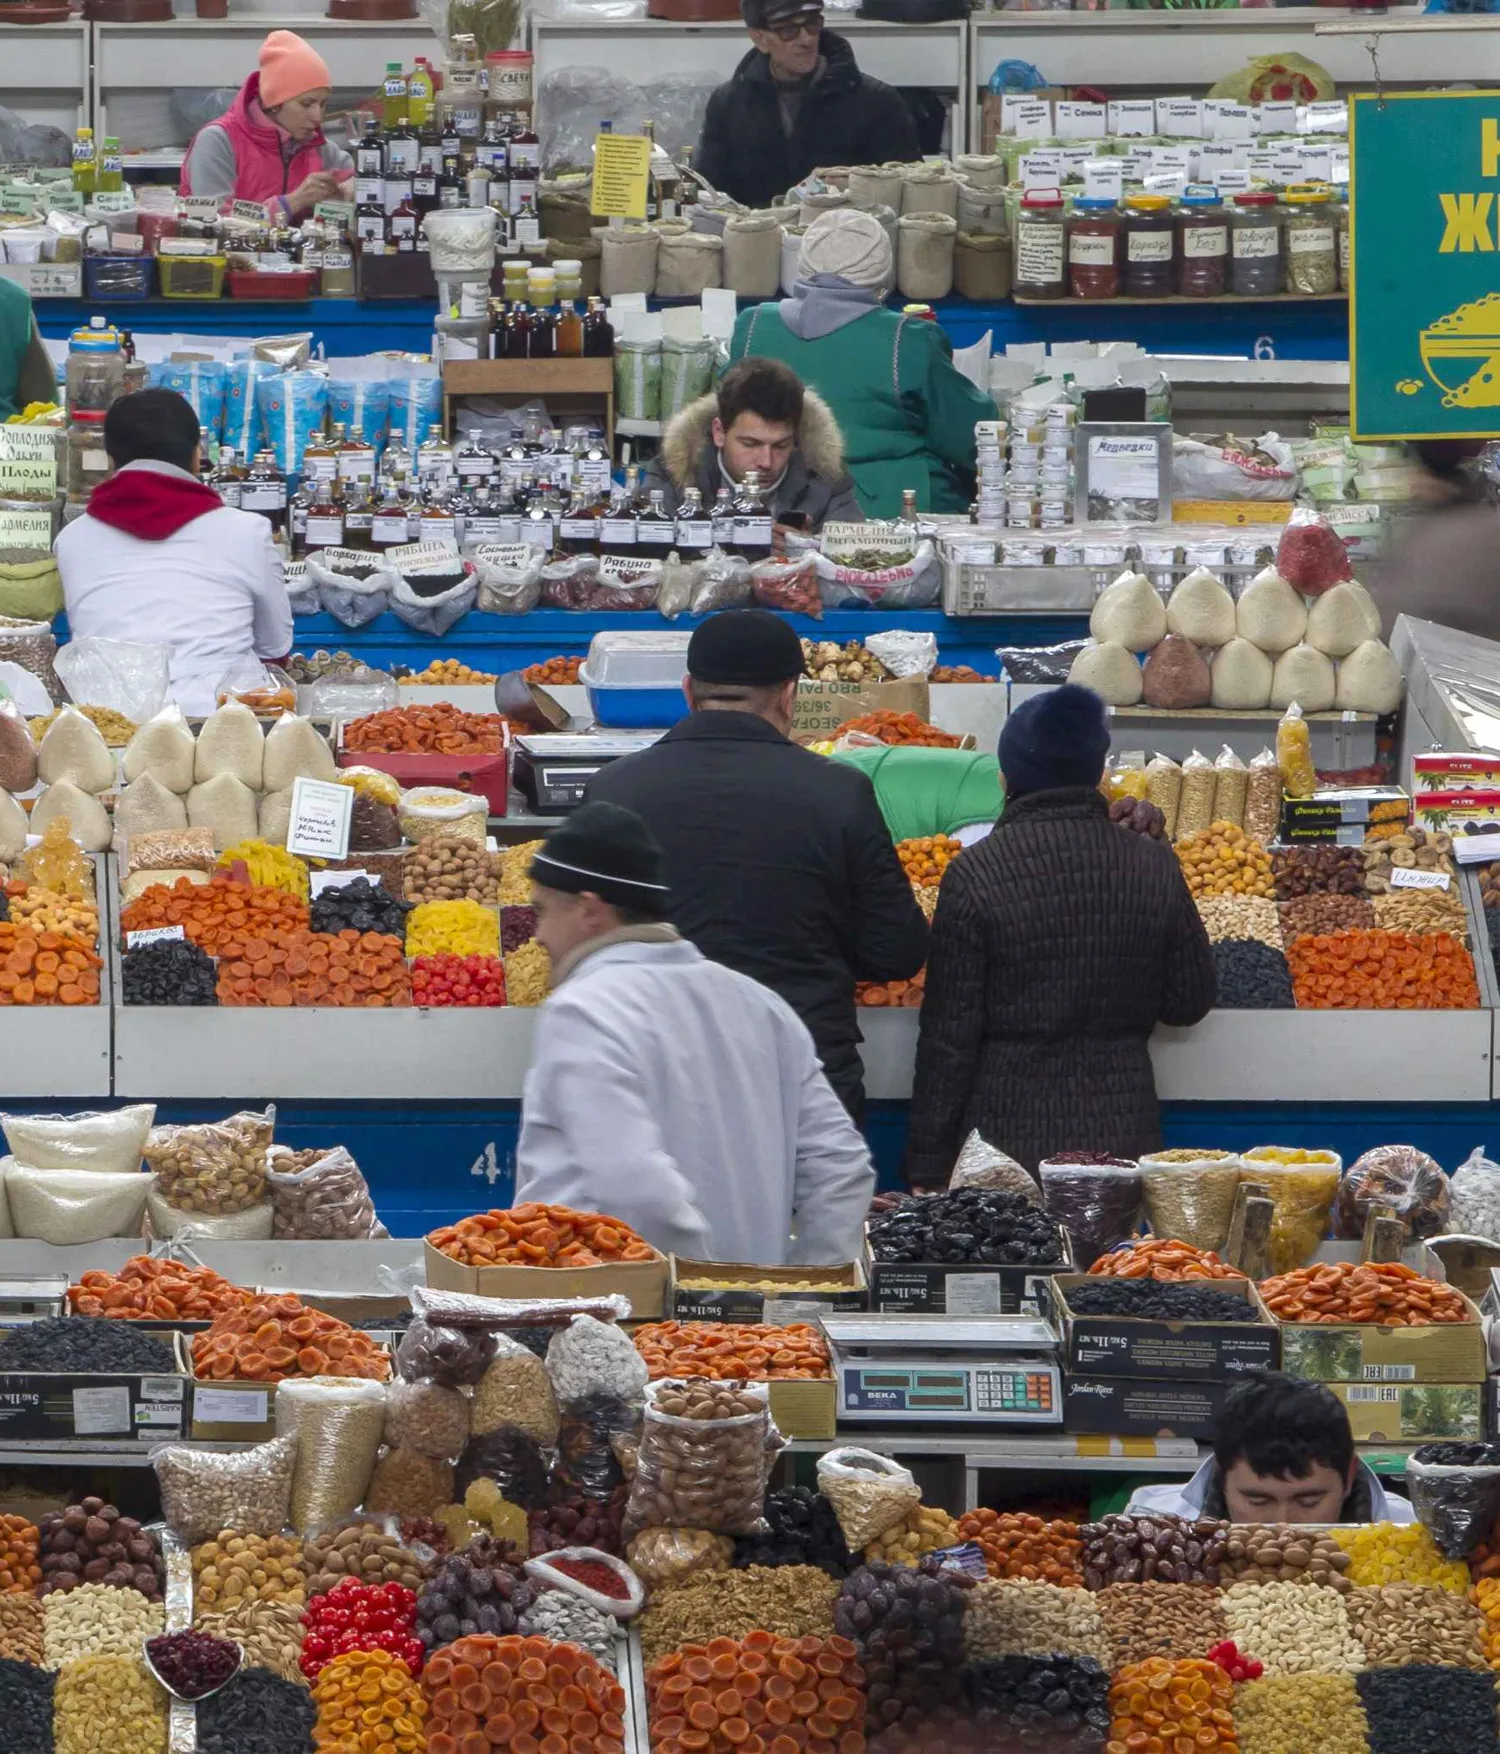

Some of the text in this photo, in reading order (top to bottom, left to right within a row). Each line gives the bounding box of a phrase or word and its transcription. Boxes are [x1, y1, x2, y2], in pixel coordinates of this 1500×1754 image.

[1439, 193, 1500, 253] Ж
[1254, 336, 1276, 360] 6
[2, 465, 51, 480] Плоды
[604, 556, 652, 571] Рябина
[470, 1142, 501, 1184] 4
